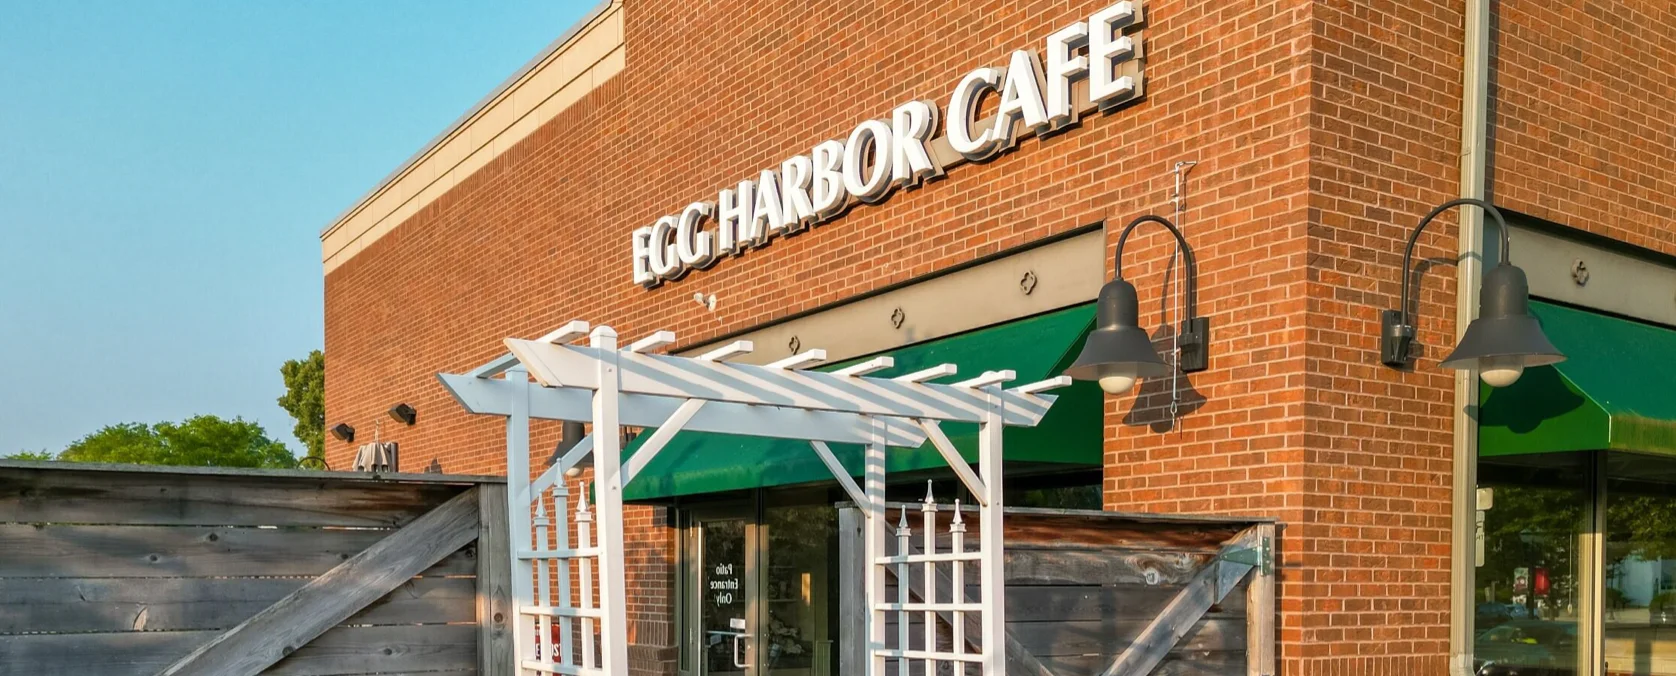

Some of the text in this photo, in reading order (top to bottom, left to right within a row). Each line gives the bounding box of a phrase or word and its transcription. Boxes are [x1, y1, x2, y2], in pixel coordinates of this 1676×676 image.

[632, 0, 1134, 285] EGG HARBOR CAFE
